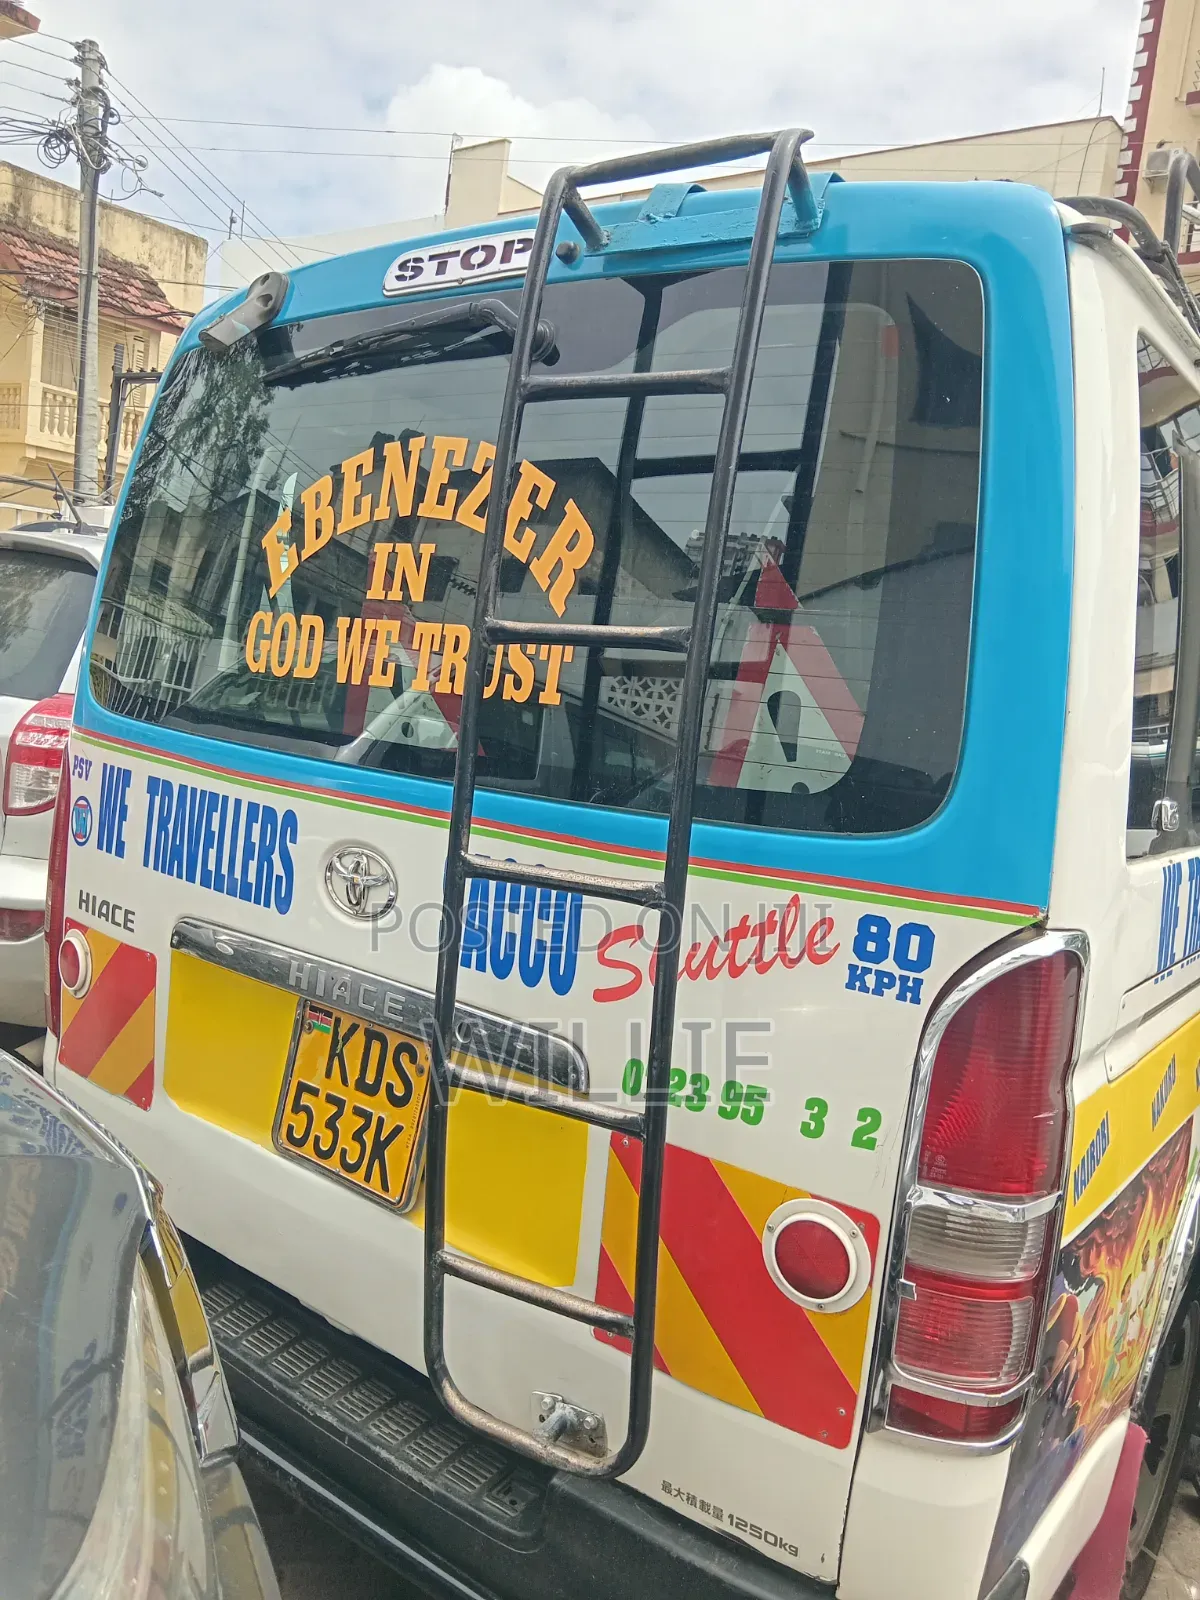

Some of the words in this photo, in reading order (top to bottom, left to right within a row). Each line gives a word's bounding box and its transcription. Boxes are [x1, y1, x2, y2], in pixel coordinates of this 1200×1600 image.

[394, 237, 535, 282] STOP
[261, 435, 596, 618] EBENEZER
[366, 541, 436, 602] IN
[245, 610, 324, 679] GOD
[335, 615, 402, 688] WE
[71, 754, 93, 781] PSV
[78, 889, 136, 933] HIACE
[96, 762, 132, 860] WE
[142, 775, 298, 916] TRAVELLERS
[443, 853, 583, 996] ACCO
[592, 893, 841, 1003] Suttle
[852, 913, 936, 974] 80
[288, 959, 406, 1022] HIACE
[845, 963, 925, 1005] KPH
[324, 1016, 418, 1108] KDS
[285, 1080, 405, 1193] 533K
[621, 1057, 711, 1113] 023
[717, 1079, 768, 1126] 95
[799, 1096, 829, 1139] 3
[850, 1106, 883, 1151] 2
[1073, 1109, 1111, 1207] NAIROBI
[660, 1479, 724, 1522] 最大積載量
[727, 1512, 799, 1558] 1250kg
